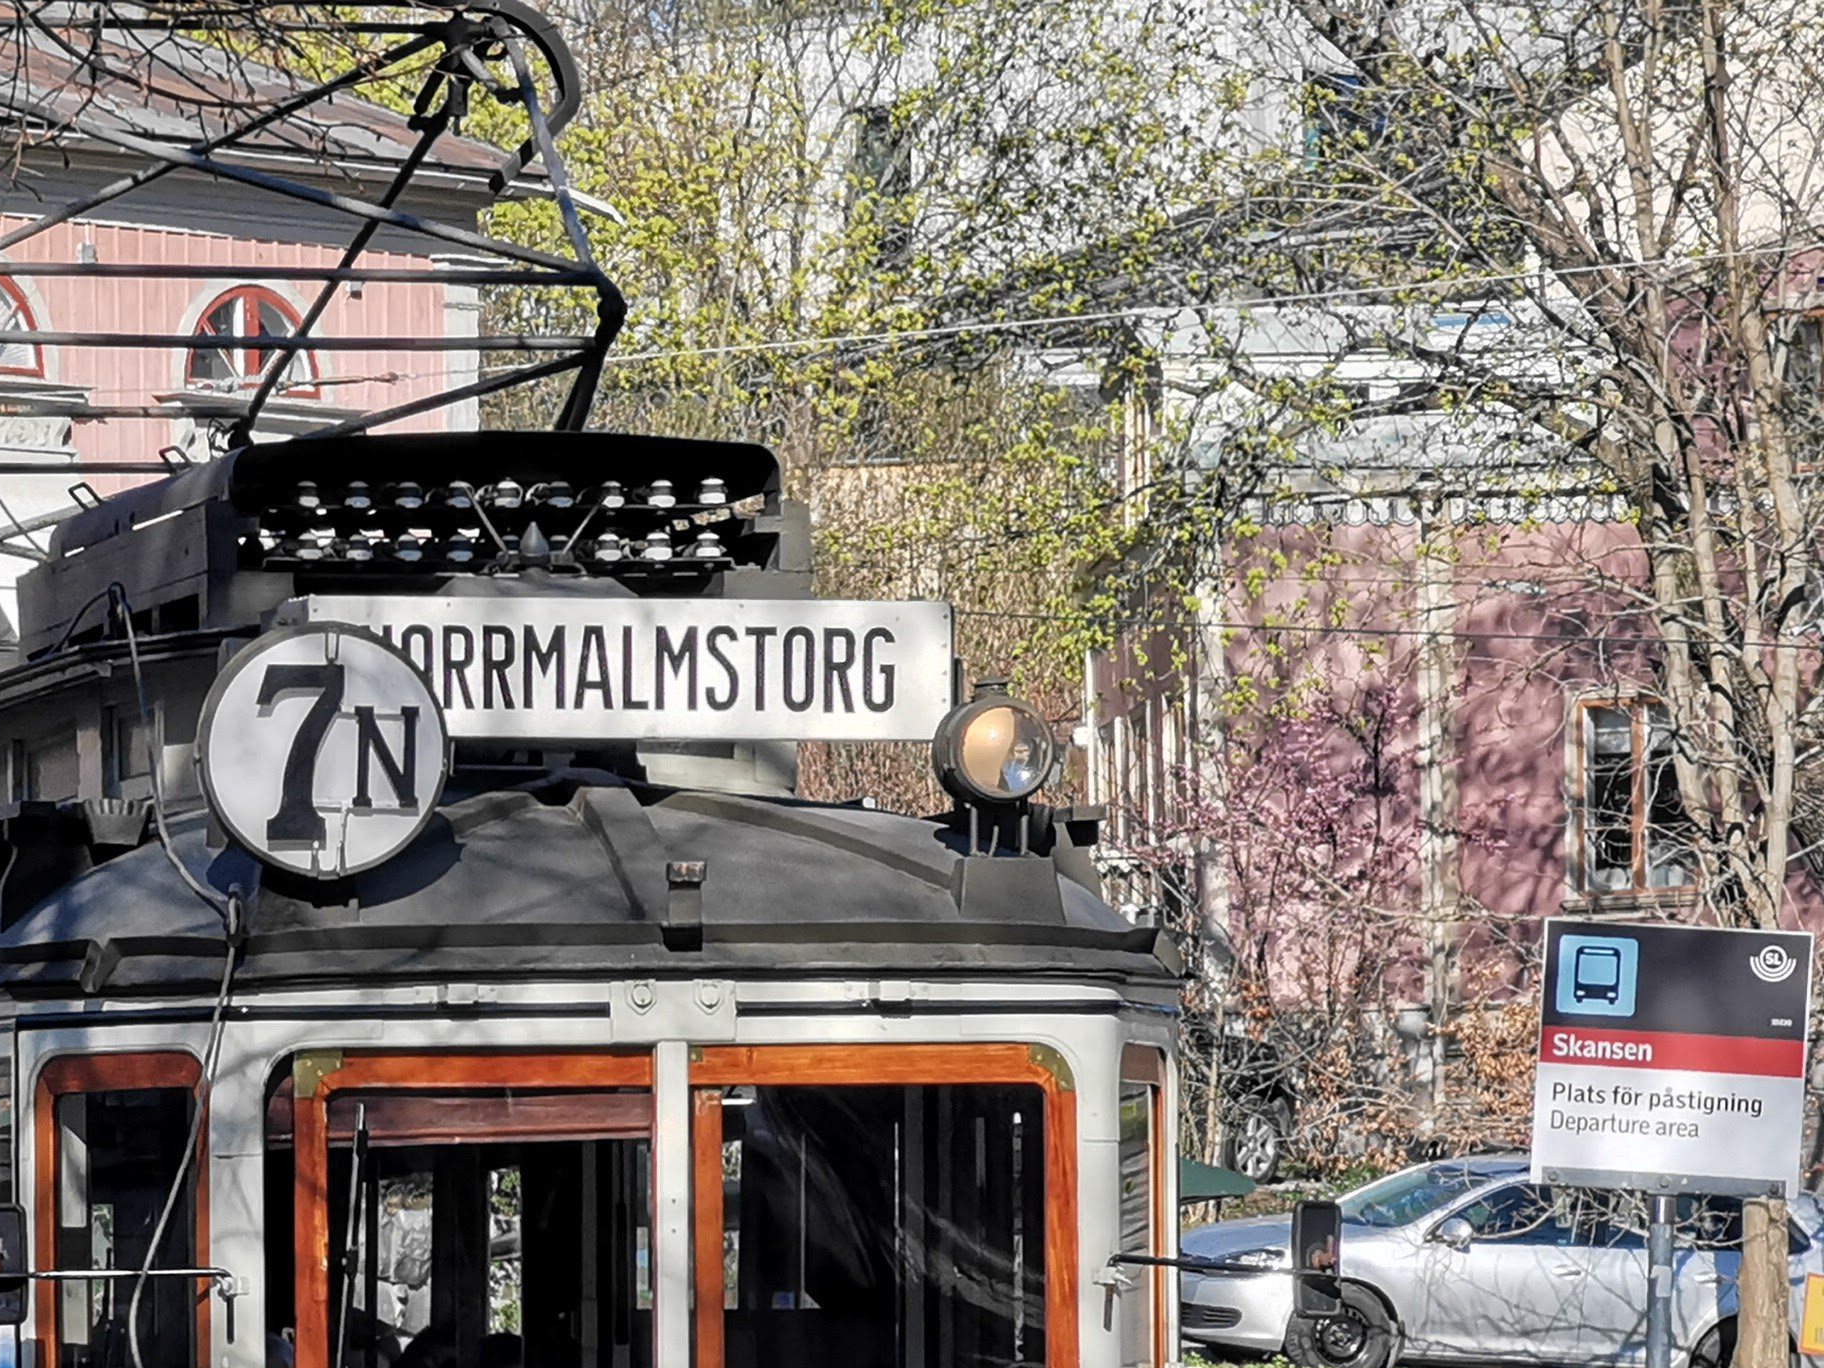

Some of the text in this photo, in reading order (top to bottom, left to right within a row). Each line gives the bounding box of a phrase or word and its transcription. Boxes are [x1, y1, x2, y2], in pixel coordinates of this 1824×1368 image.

[1765, 952, 1782, 966] SL
[1552, 1033, 1653, 1062] Skansen
[1552, 1082, 1763, 1118] Plats för påstigning
[1550, 1109, 1700, 1138] Departure area
